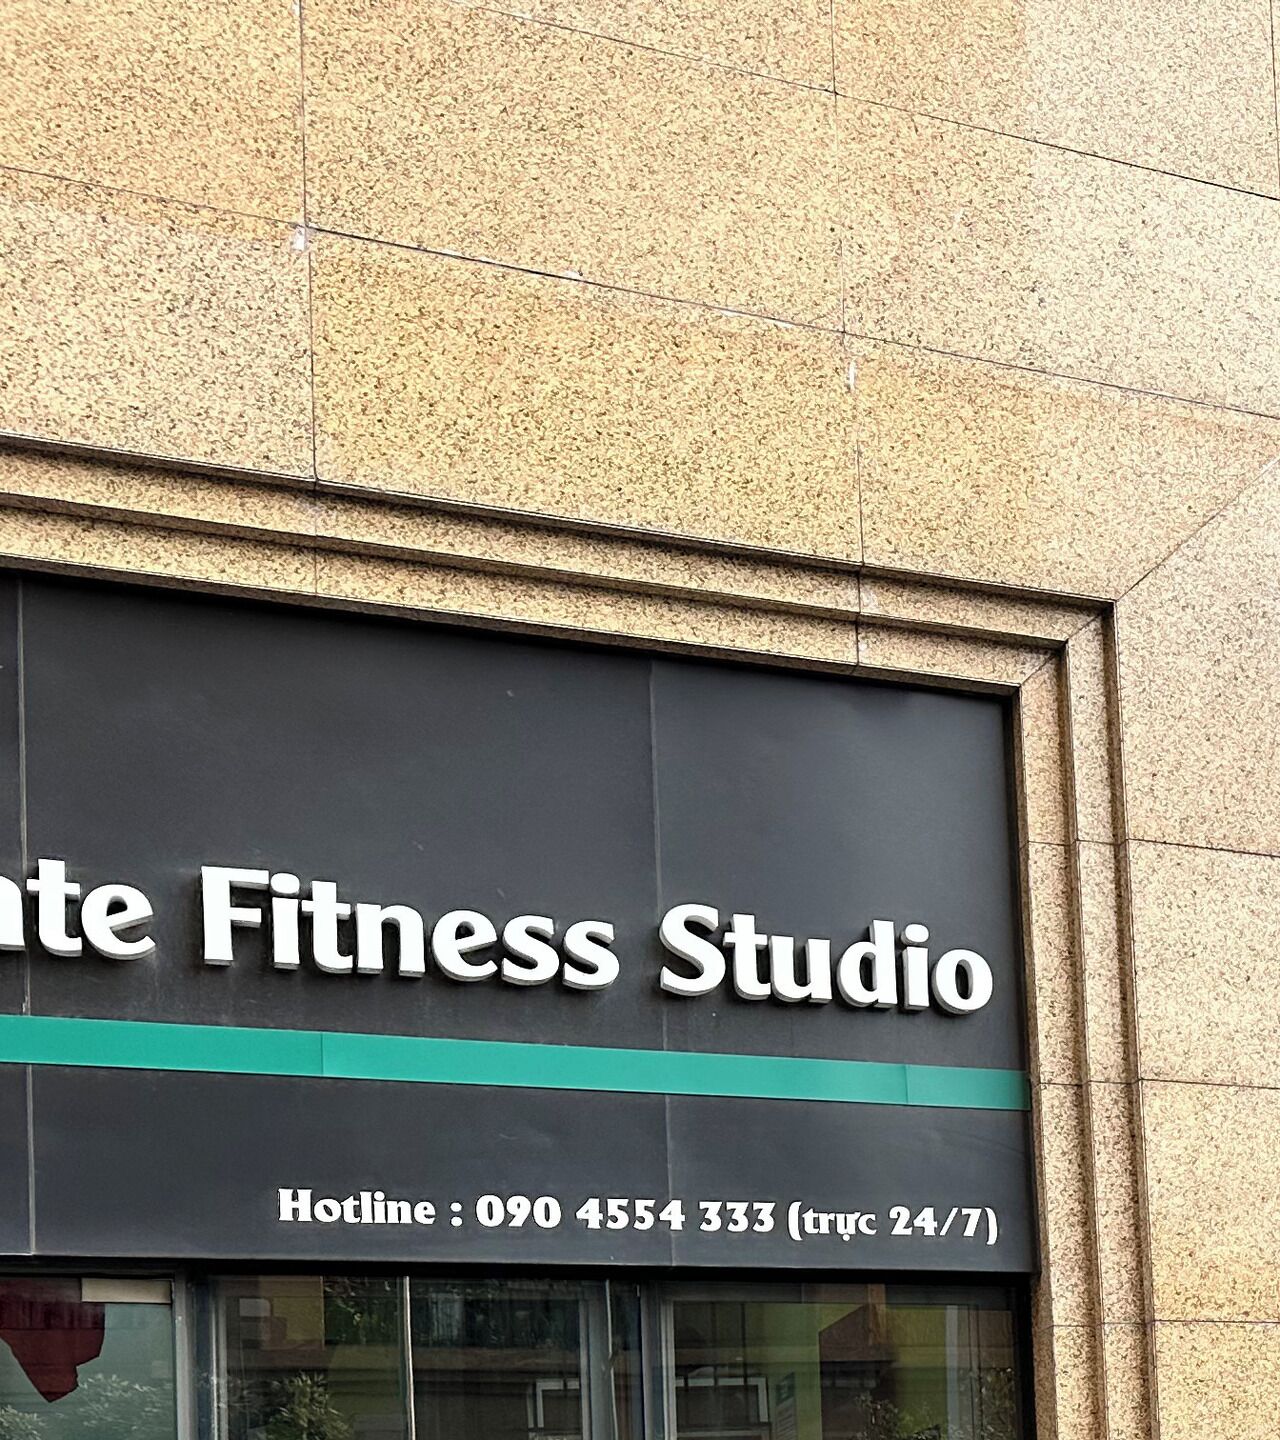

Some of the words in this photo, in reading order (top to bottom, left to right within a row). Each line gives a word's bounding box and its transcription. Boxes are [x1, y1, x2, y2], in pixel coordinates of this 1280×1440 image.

[199, 864, 620, 991] Fitness
[658, 902, 996, 1018] Studio
[278, 1188, 436, 1226] Hotline
[475, 1194, 562, 1230] 090
[575, 1198, 687, 1232] 4554
[698, 1201, 776, 1233] 333
[787, 1204, 878, 1243] (trực
[889, 1205, 999, 1246] 24/7)
